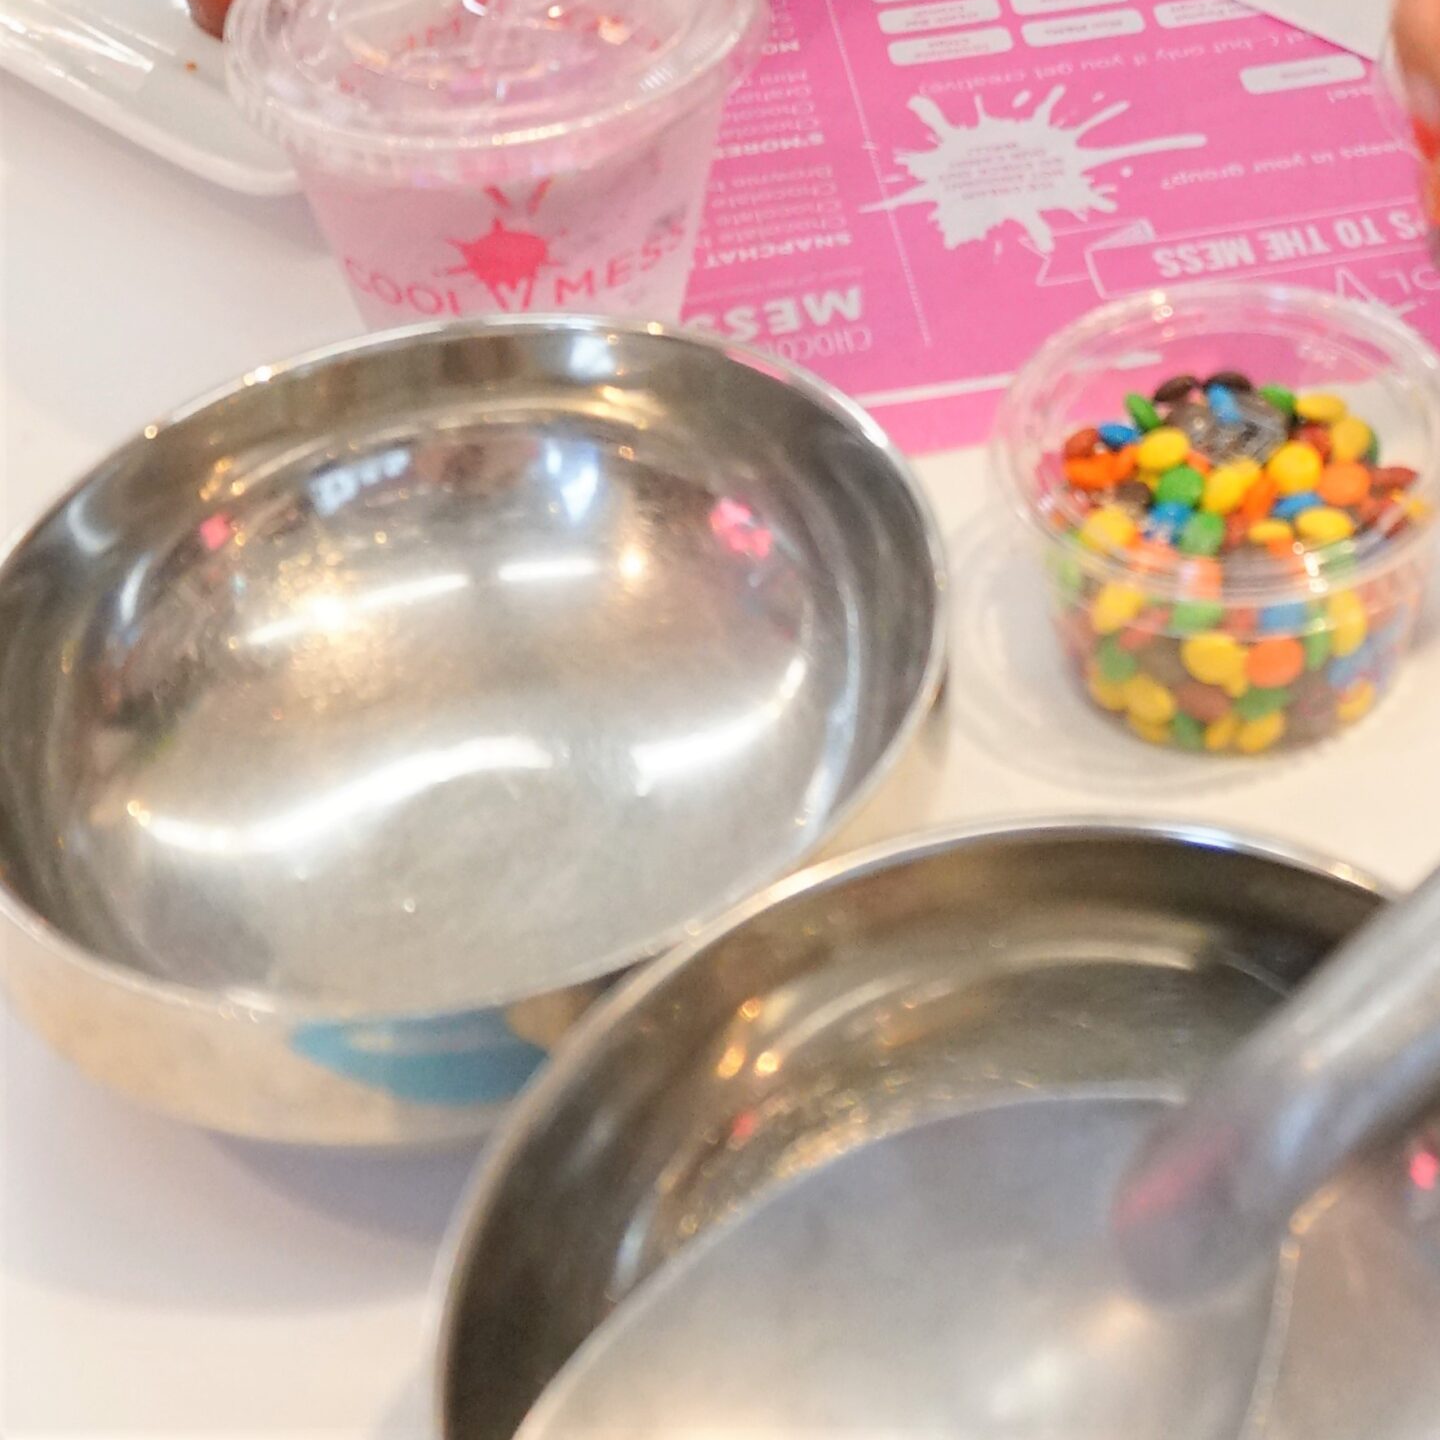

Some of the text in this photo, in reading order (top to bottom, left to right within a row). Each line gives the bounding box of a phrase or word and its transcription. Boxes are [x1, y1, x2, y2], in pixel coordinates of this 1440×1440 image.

[702, 230, 855, 270] SNAPCHAT
[1257, 223, 1332, 262] THE
[1332, 215, 1388, 250] TO
[1152, 234, 1256, 278] MESS
